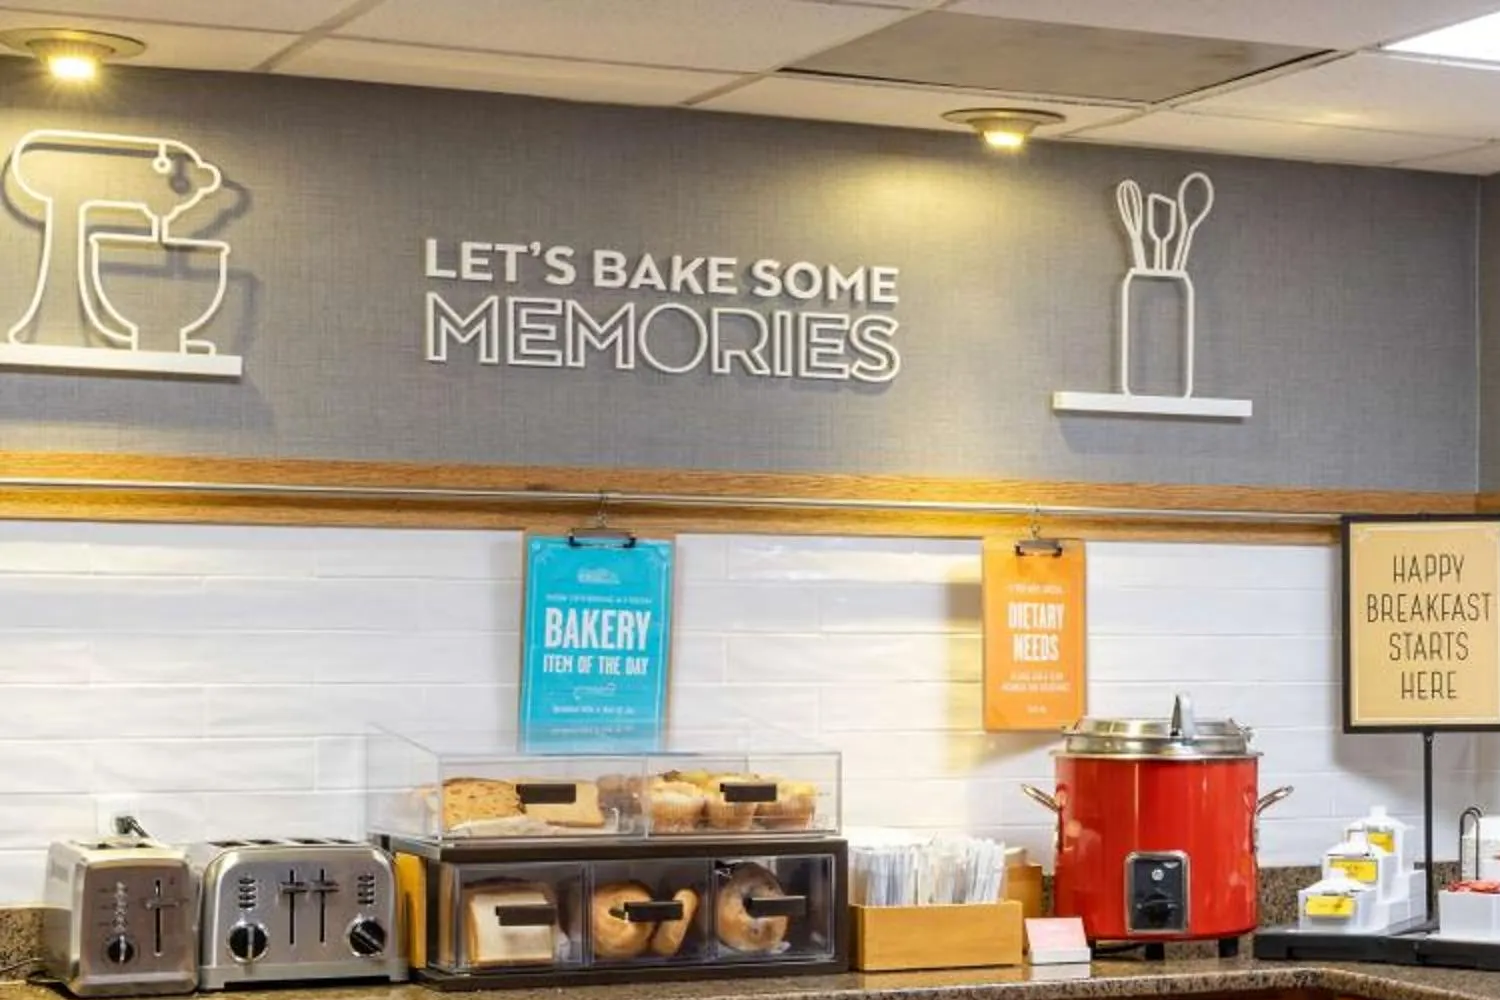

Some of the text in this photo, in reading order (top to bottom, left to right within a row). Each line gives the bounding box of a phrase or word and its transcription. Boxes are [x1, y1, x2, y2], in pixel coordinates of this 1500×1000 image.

[425, 238, 900, 304] LET'S BAKE SOME
[425, 291, 901, 383] MEMORIES
[1392, 553, 1465, 584] HAPPY
[1008, 602, 1065, 632] DIETARY
[1366, 591, 1492, 624] BREAKFAST
[544, 606, 652, 651] BAKERY
[1013, 634, 1060, 662] NEEDS
[1389, 631, 1470, 662] STARTS
[543, 654, 650, 676] ITEM OF THE DAY
[1401, 670, 1459, 701] HERE
